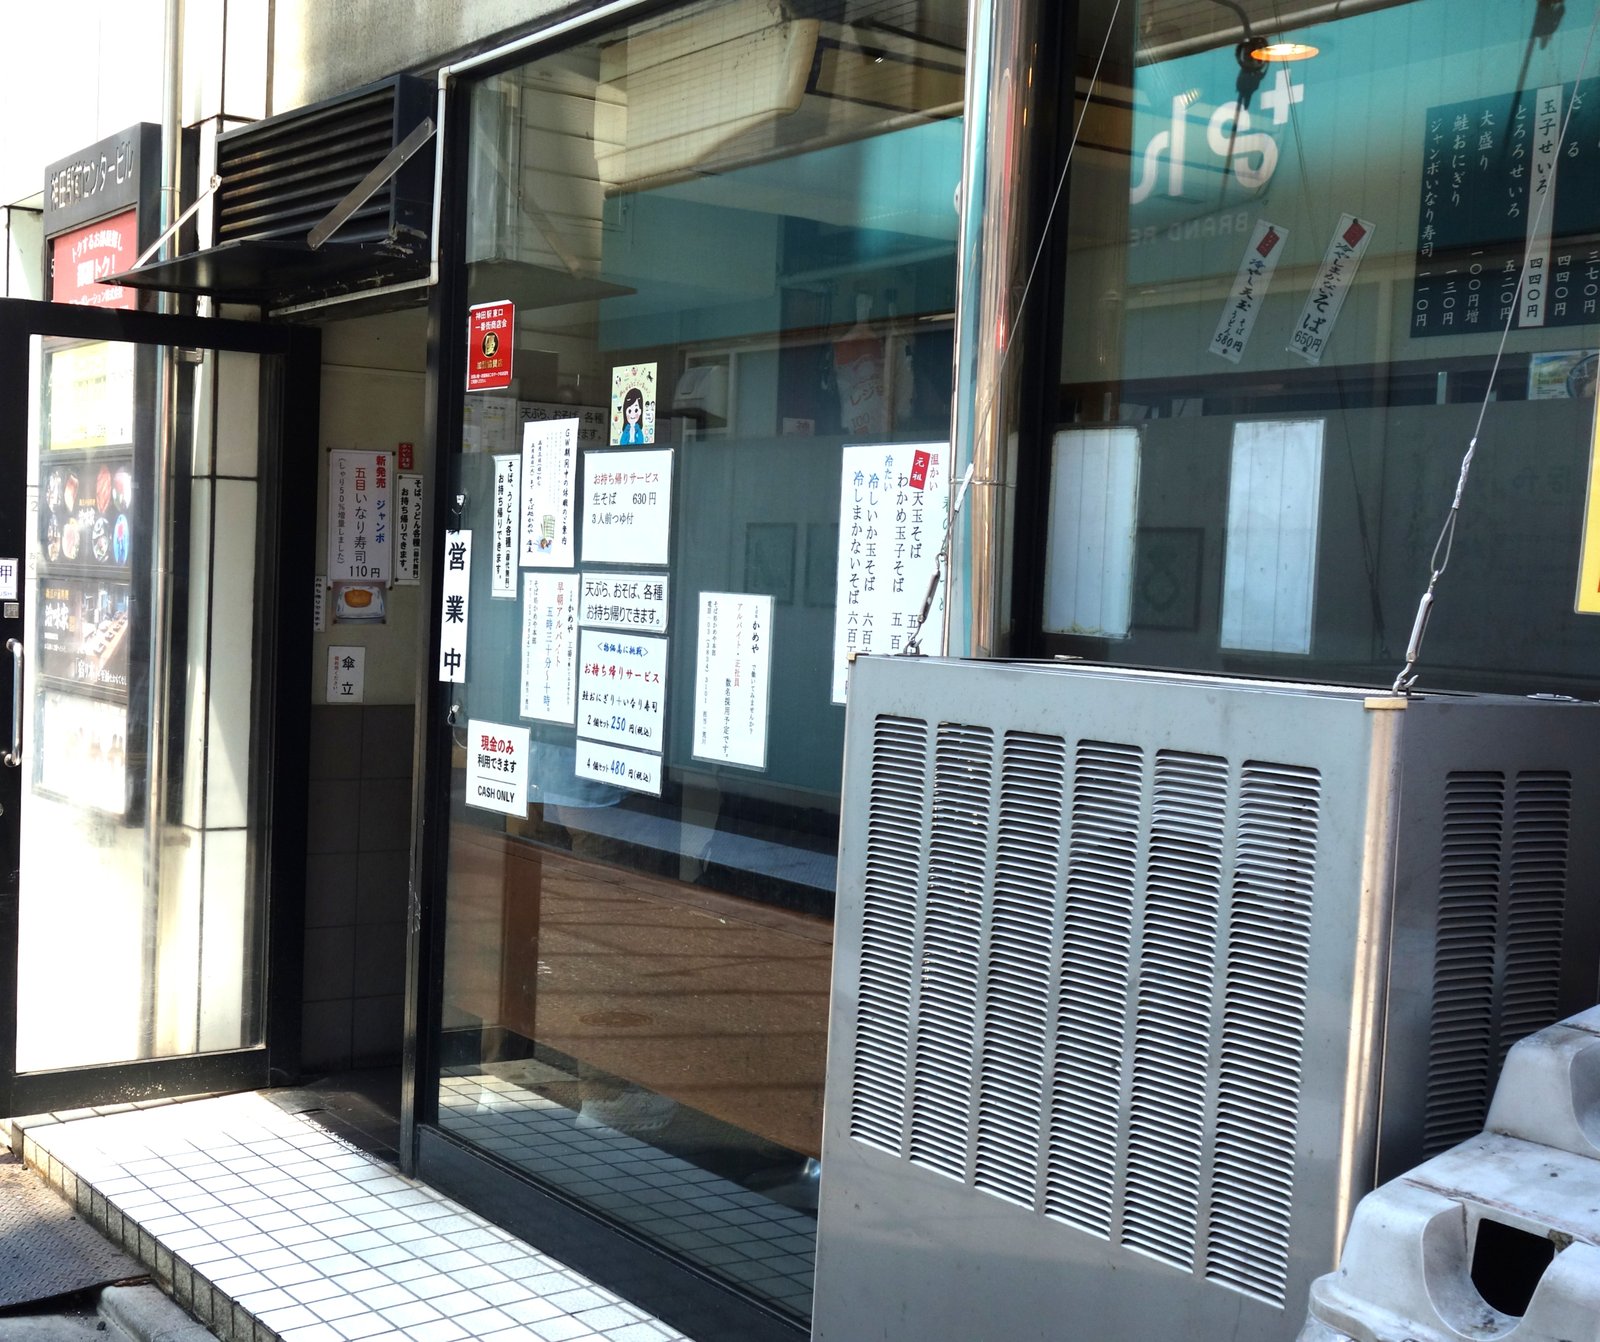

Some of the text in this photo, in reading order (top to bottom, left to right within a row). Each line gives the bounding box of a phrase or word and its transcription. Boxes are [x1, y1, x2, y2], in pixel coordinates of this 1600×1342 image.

[1478, 109, 1495, 171] 大盛り
[1536, 99, 1557, 195] 玉子せいろ
[1451, 114, 1469, 208] 鮭おにぎり
[1507, 104, 1527, 218] とろろせいろ
[1421, 119, 1442, 258] ジャンボいなり寿司
[1215, 332, 1243, 353] 580円
[1294, 330, 1322, 352] 650円
[593, 472, 659, 485] お持ち帰りサービス
[883, 454, 894, 492] 冷たい
[912, 457, 926, 482] 元祖
[929, 453, 940, 491] 温かい
[354, 467, 367, 564] 五目いなり寿司
[376, 455, 386, 544] 新発売 ジャンボ
[592, 492, 657, 506] 生そば 630円
[495, 474, 504, 579] お持ち帰りできます。
[591, 512, 634, 525] 3人前つゆ付
[848, 470, 865, 605] 冷しまかないそば
[864, 473, 880, 592] 冷しいか玉そば
[893, 473, 909, 593] わかめ玉子そば
[910, 491, 924, 559] 天玉そば
[349, 565, 380, 578] 110円
[444, 542, 466, 676] 営業中
[585, 581, 663, 601] 天ぷら、おそば、各種
[555, 582, 564, 667] 早朝アルバイト
[567, 604, 575, 634] かめや
[586, 604, 660, 625] お持ち帰りできます。
[752, 620, 760, 654] かめや
[584, 663, 660, 684] お持ち帰りサービス
[477, 753, 517, 774] 利用できます
[481, 735, 514, 755] 現金のみ
[477, 785, 515, 803] CASH ONLY
